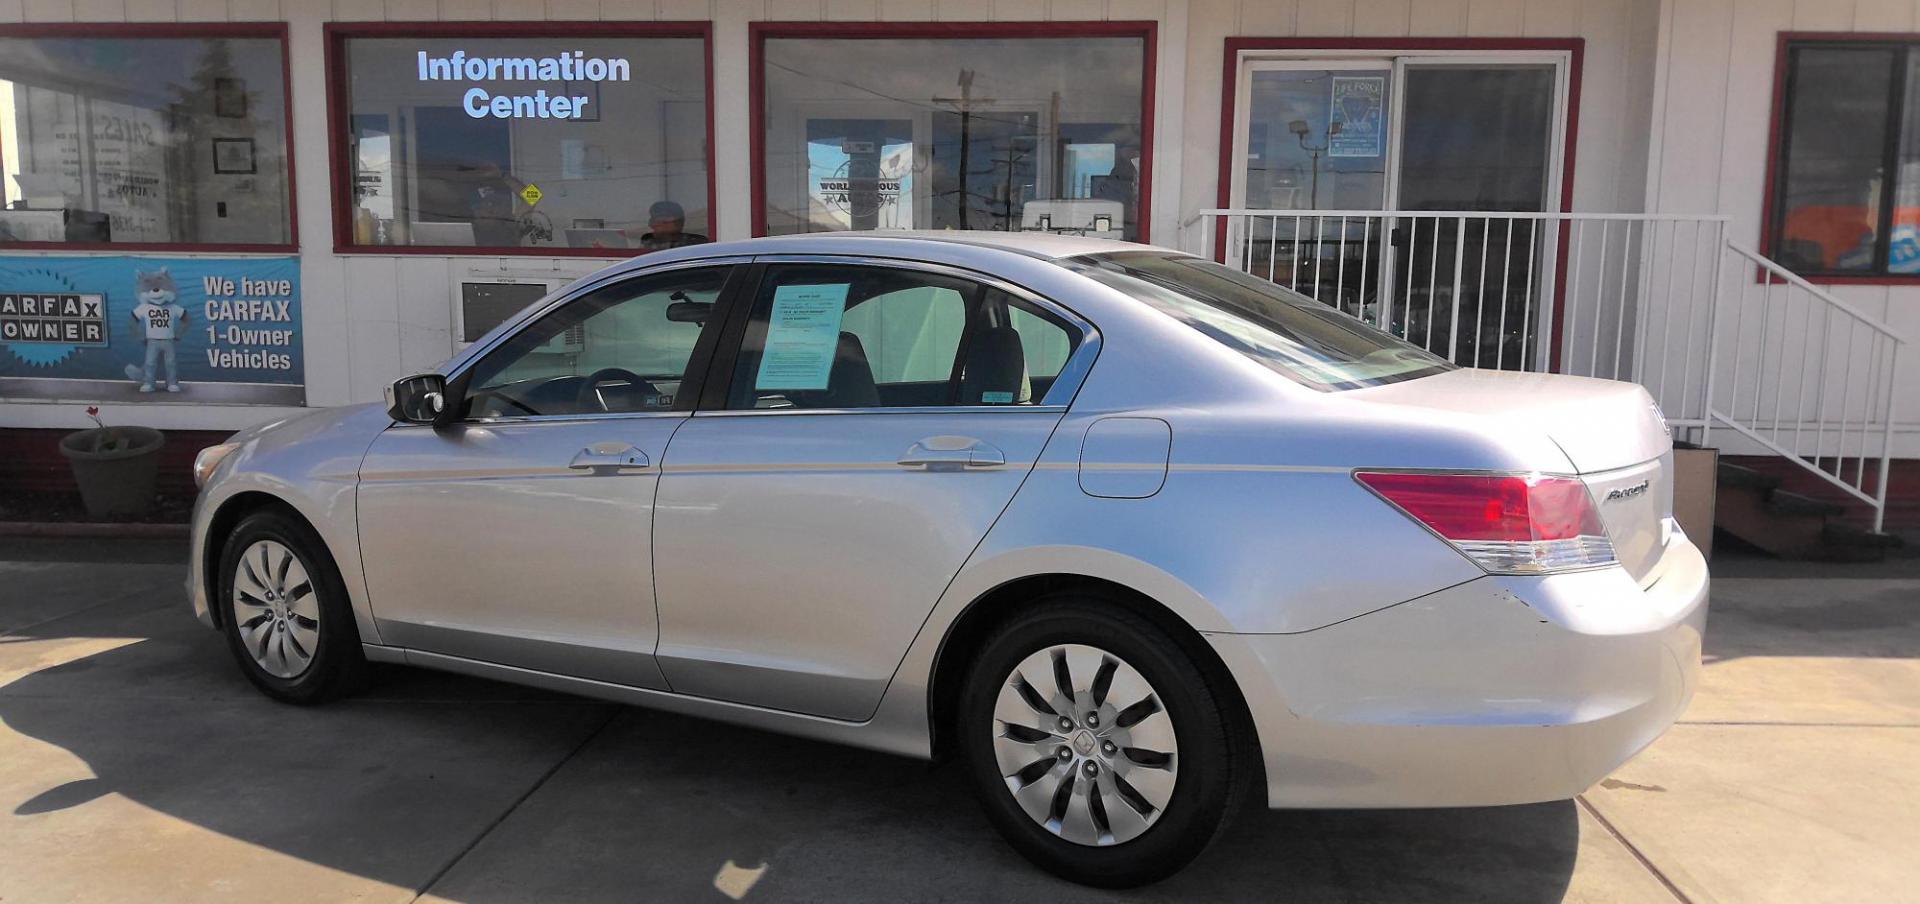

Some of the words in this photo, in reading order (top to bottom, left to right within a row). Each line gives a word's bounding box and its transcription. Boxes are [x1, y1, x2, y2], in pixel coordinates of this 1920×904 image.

[417, 50, 630, 81] Information
[463, 88, 588, 119] Center
[204, 276, 235, 296] We
[241, 276, 291, 296] have
[148, 309, 170, 318] CAR
[205, 299, 291, 321] CARFAX
[4, 322, 100, 339] OWNER
[150, 319, 170, 328] FOX
[206, 325, 292, 345] 1-Owner
[207, 348, 291, 369] Vehicles
